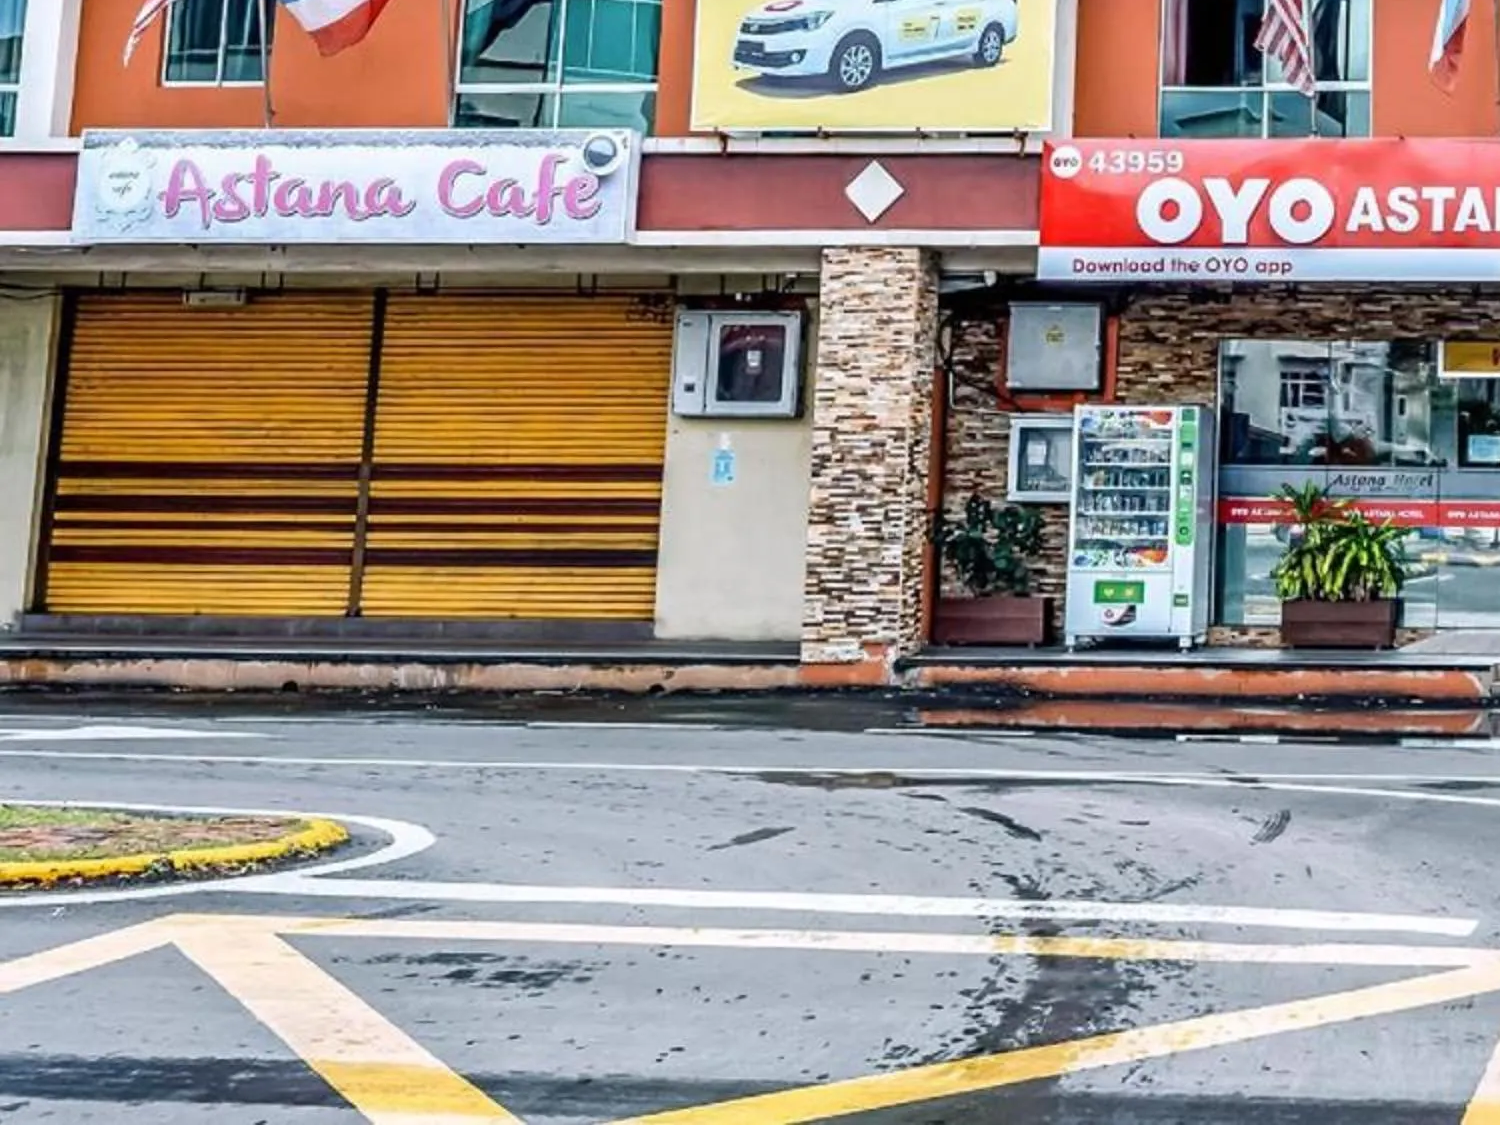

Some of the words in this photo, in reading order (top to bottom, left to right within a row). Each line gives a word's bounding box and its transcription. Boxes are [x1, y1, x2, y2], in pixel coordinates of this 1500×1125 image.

[1053, 157, 1078, 168] OYO
[1088, 150, 1184, 174] 43959
[158, 153, 417, 230] Astana
[1136, 177, 1335, 244] OYO
[1072, 257, 1165, 274] Download
[1170, 257, 1201, 274] the
[1205, 257, 1249, 274] OYO
[1255, 259, 1293, 277] app
[1332, 474, 1386, 487] Astana
